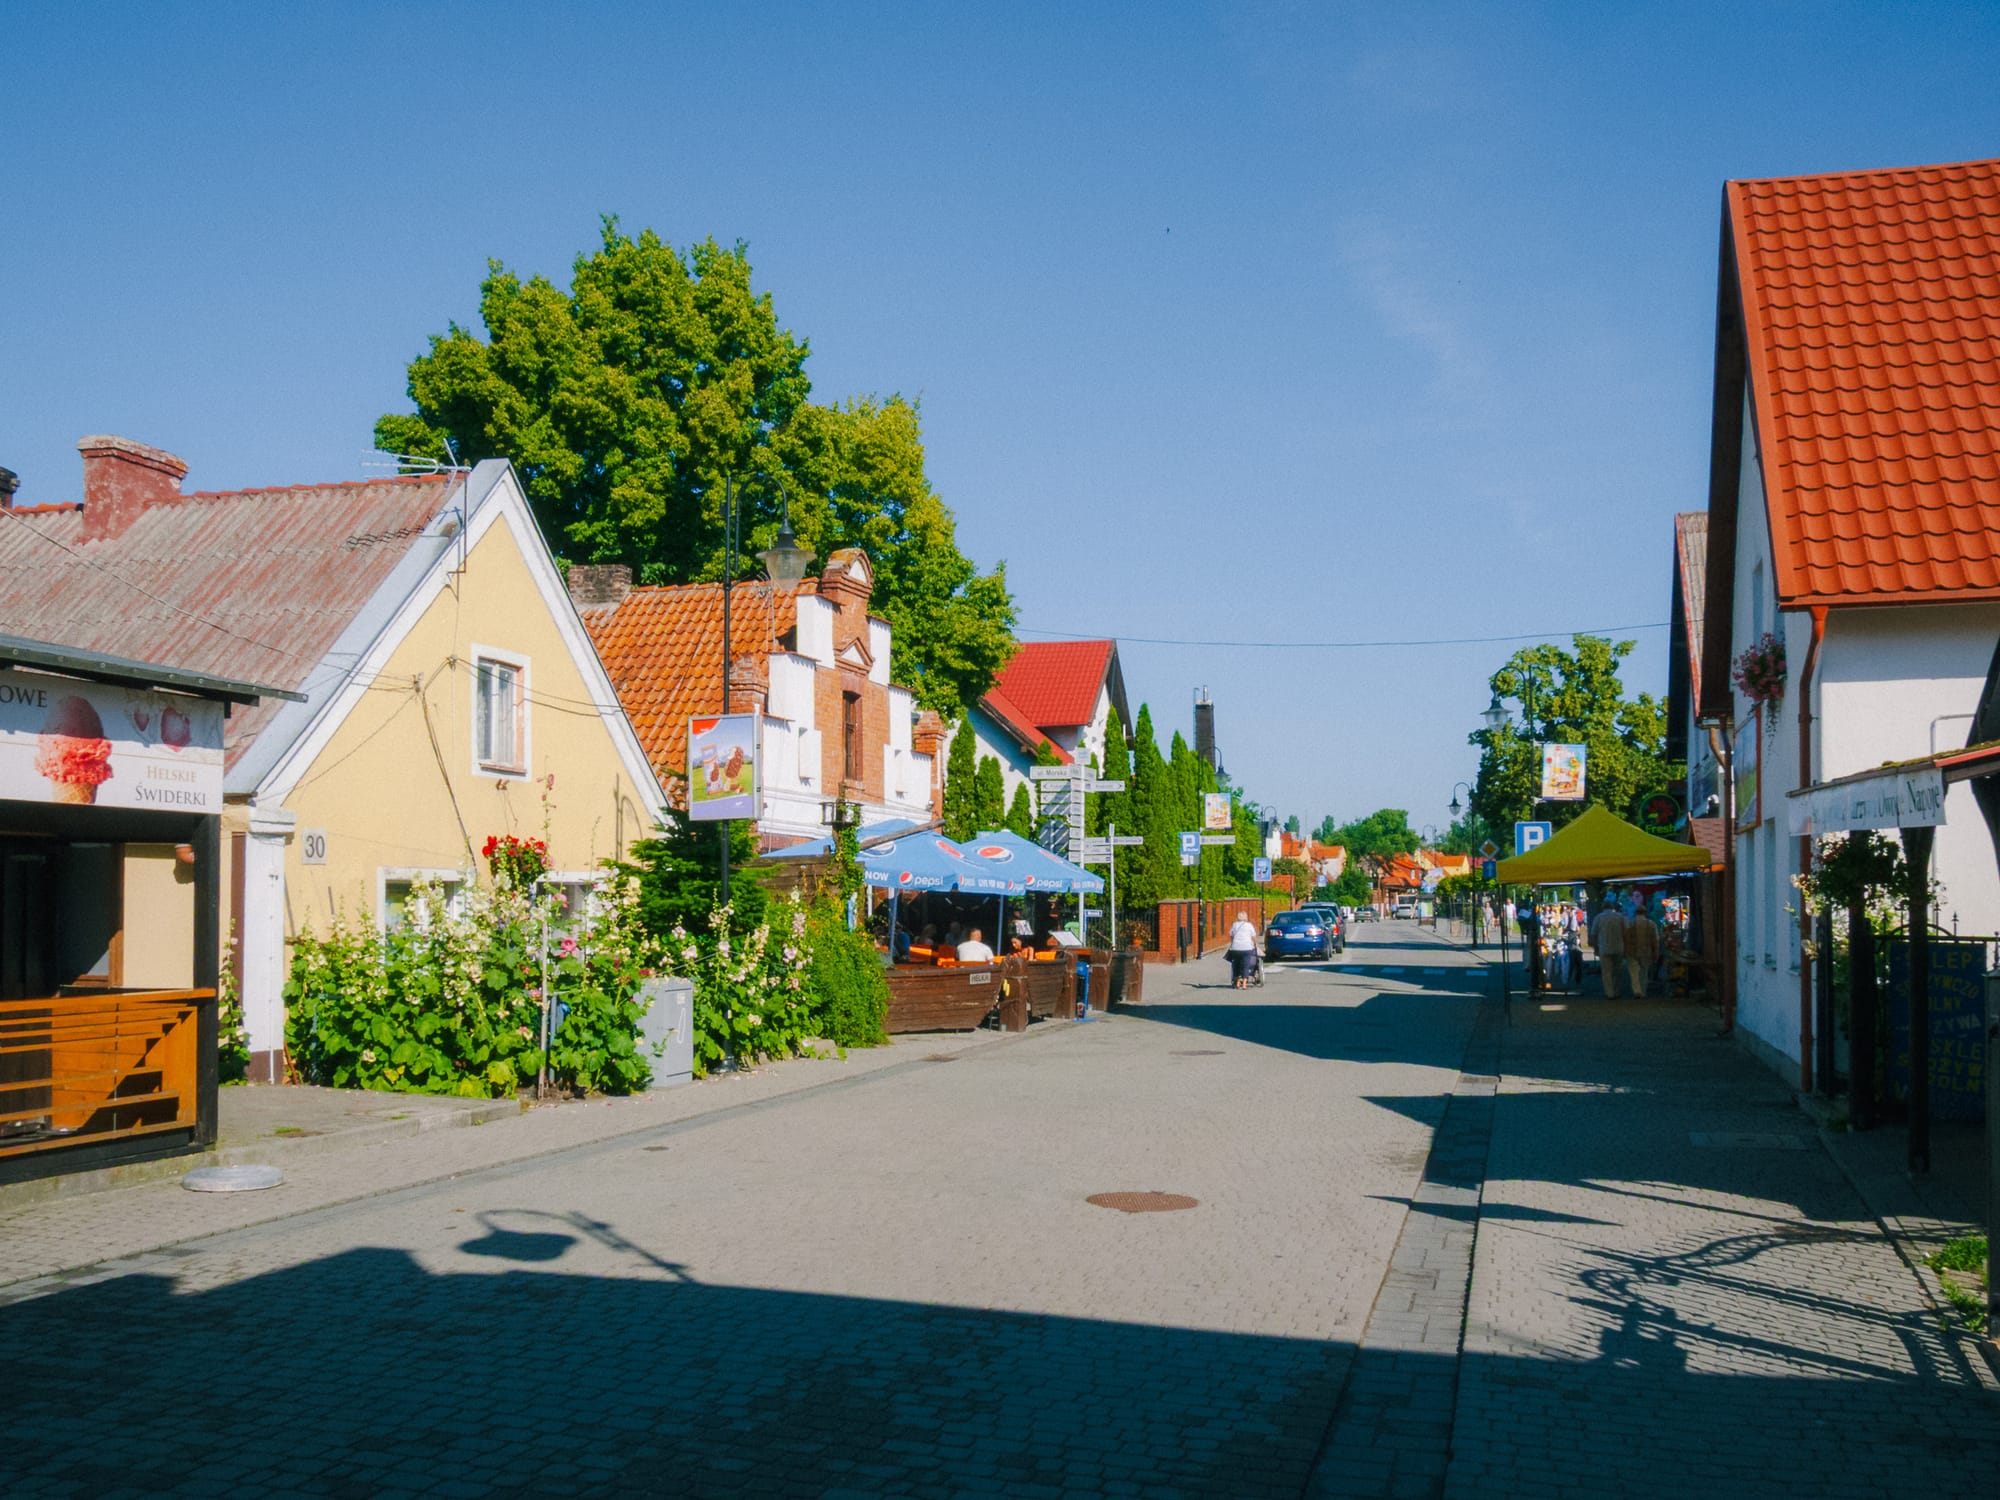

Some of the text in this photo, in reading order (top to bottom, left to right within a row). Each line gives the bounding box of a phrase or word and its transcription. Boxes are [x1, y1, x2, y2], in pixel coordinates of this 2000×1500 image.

[146, 764, 198, 784] HELSKIE
[135, 781, 206, 807] ŚWIDERKI
[1906, 776, 1941, 820] Napoje
[305, 834, 325, 858] 30
[864, 870, 889, 881] NOW
[914, 875, 944, 887] pepsi
[1036, 879, 1064, 889] pepsi
